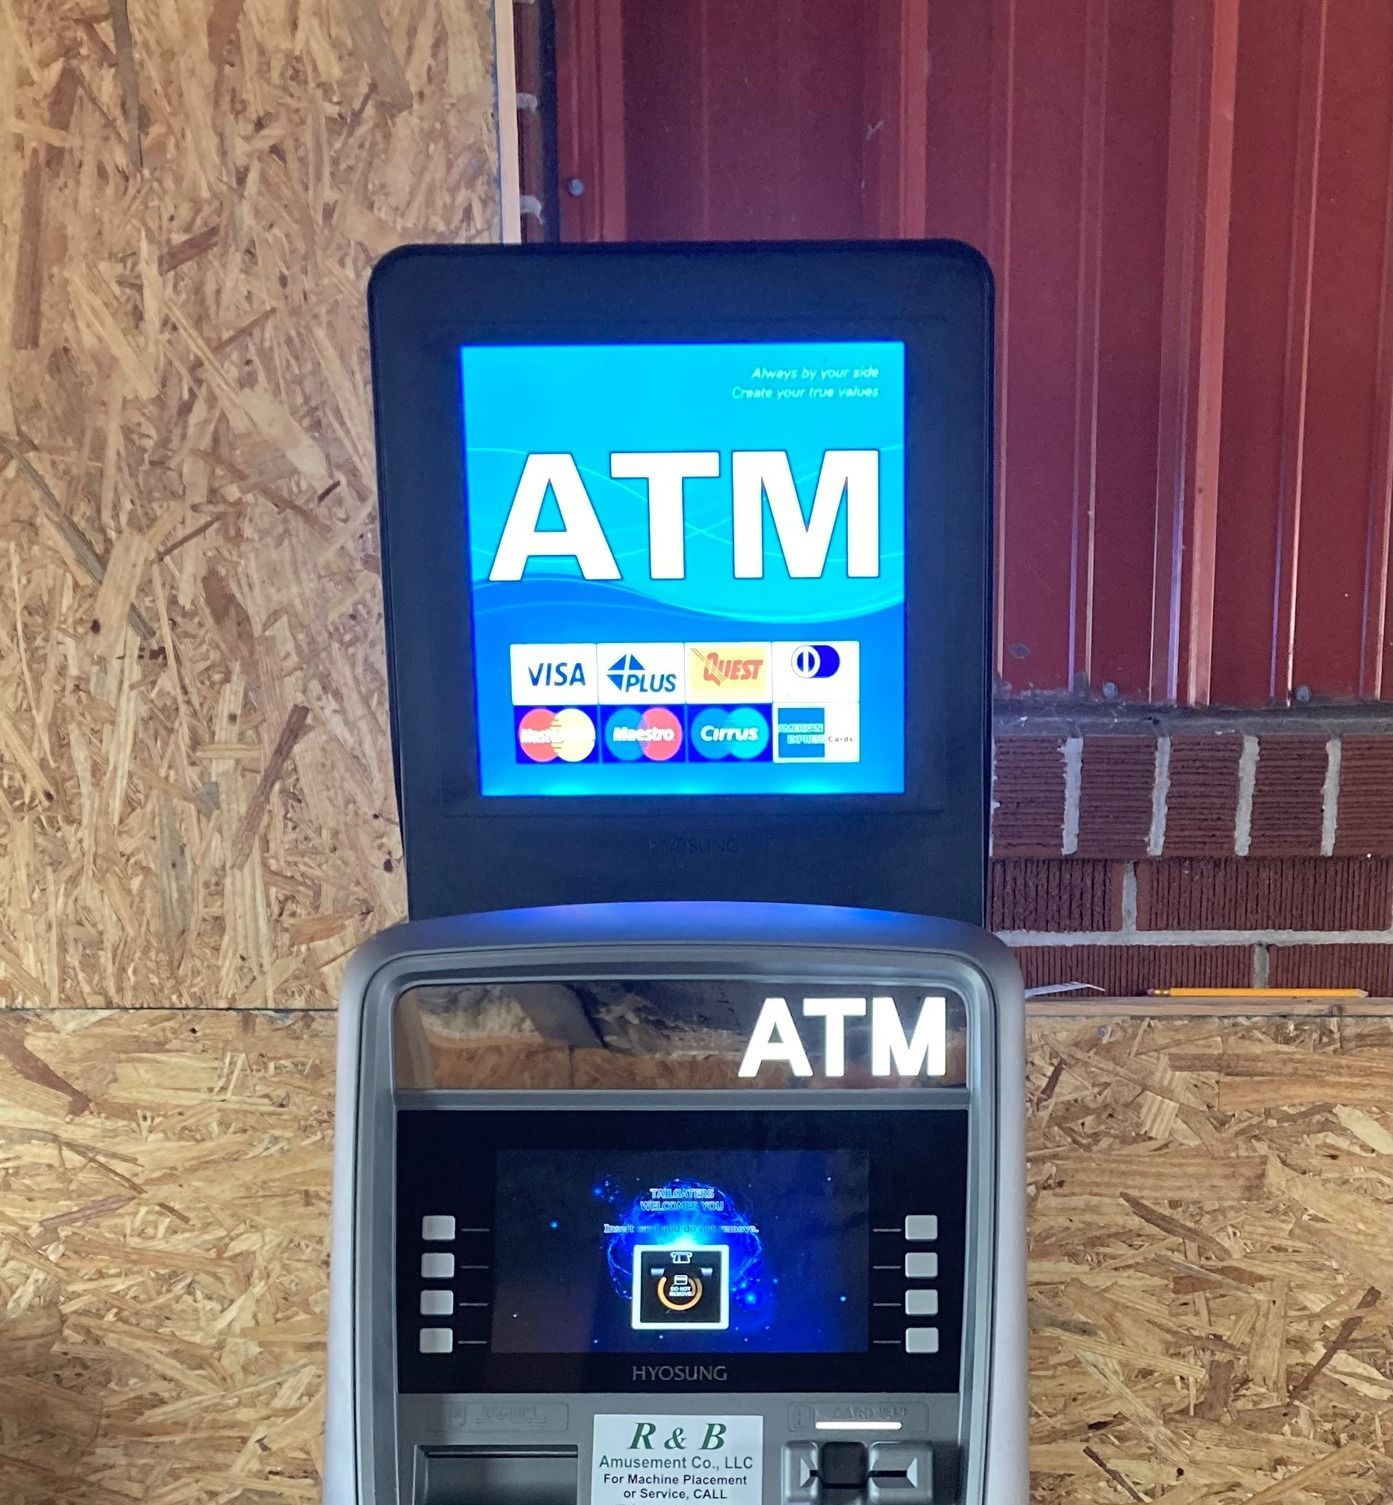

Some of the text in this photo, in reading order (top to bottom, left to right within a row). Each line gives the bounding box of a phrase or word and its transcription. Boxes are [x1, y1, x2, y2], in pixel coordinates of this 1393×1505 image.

[752, 366, 880, 380] Always by your side
[732, 386, 879, 400] Create your true values
[487, 449, 881, 582] ATM
[528, 662, 586, 686] VISA
[625, 673, 677, 693] PLUS
[613, 727, 675, 742] Maestro
[700, 725, 759, 742] Cirrus
[737, 997, 946, 1078] ATM
[700, 1201, 724, 1211] YOU
[632, 1366, 728, 1381] HYOSUNG
[626, 1422, 727, 1450] R & B
[599, 1455, 753, 1471] Amusement Co., LLC
[603, 1474, 748, 1485] For Machine Placement
[623, 1489, 728, 1501] or Service, CALL
